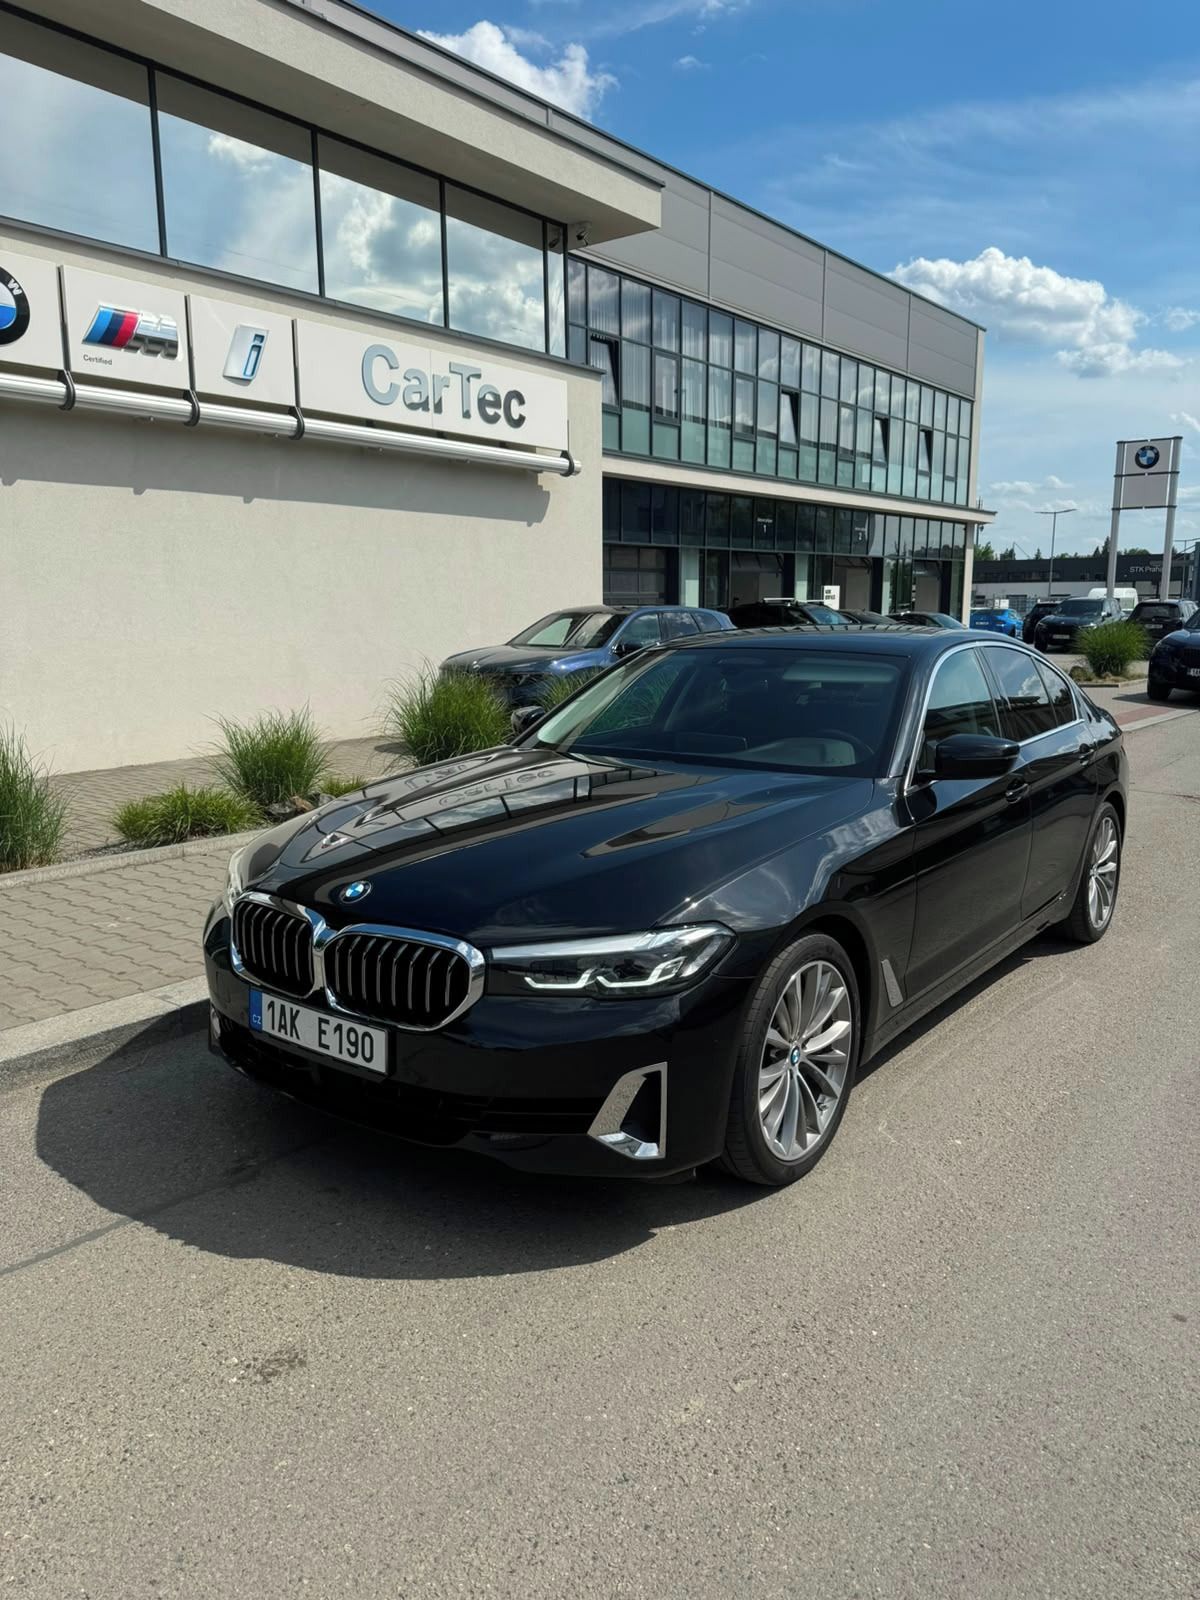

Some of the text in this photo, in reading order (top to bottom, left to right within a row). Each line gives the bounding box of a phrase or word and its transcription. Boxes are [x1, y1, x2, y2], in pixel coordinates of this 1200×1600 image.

[83, 353, 113, 366] Certified
[361, 343, 527, 429] CarTec
[252, 1013, 262, 1025] CZ
[267, 1000, 374, 1064] 1AK E190
